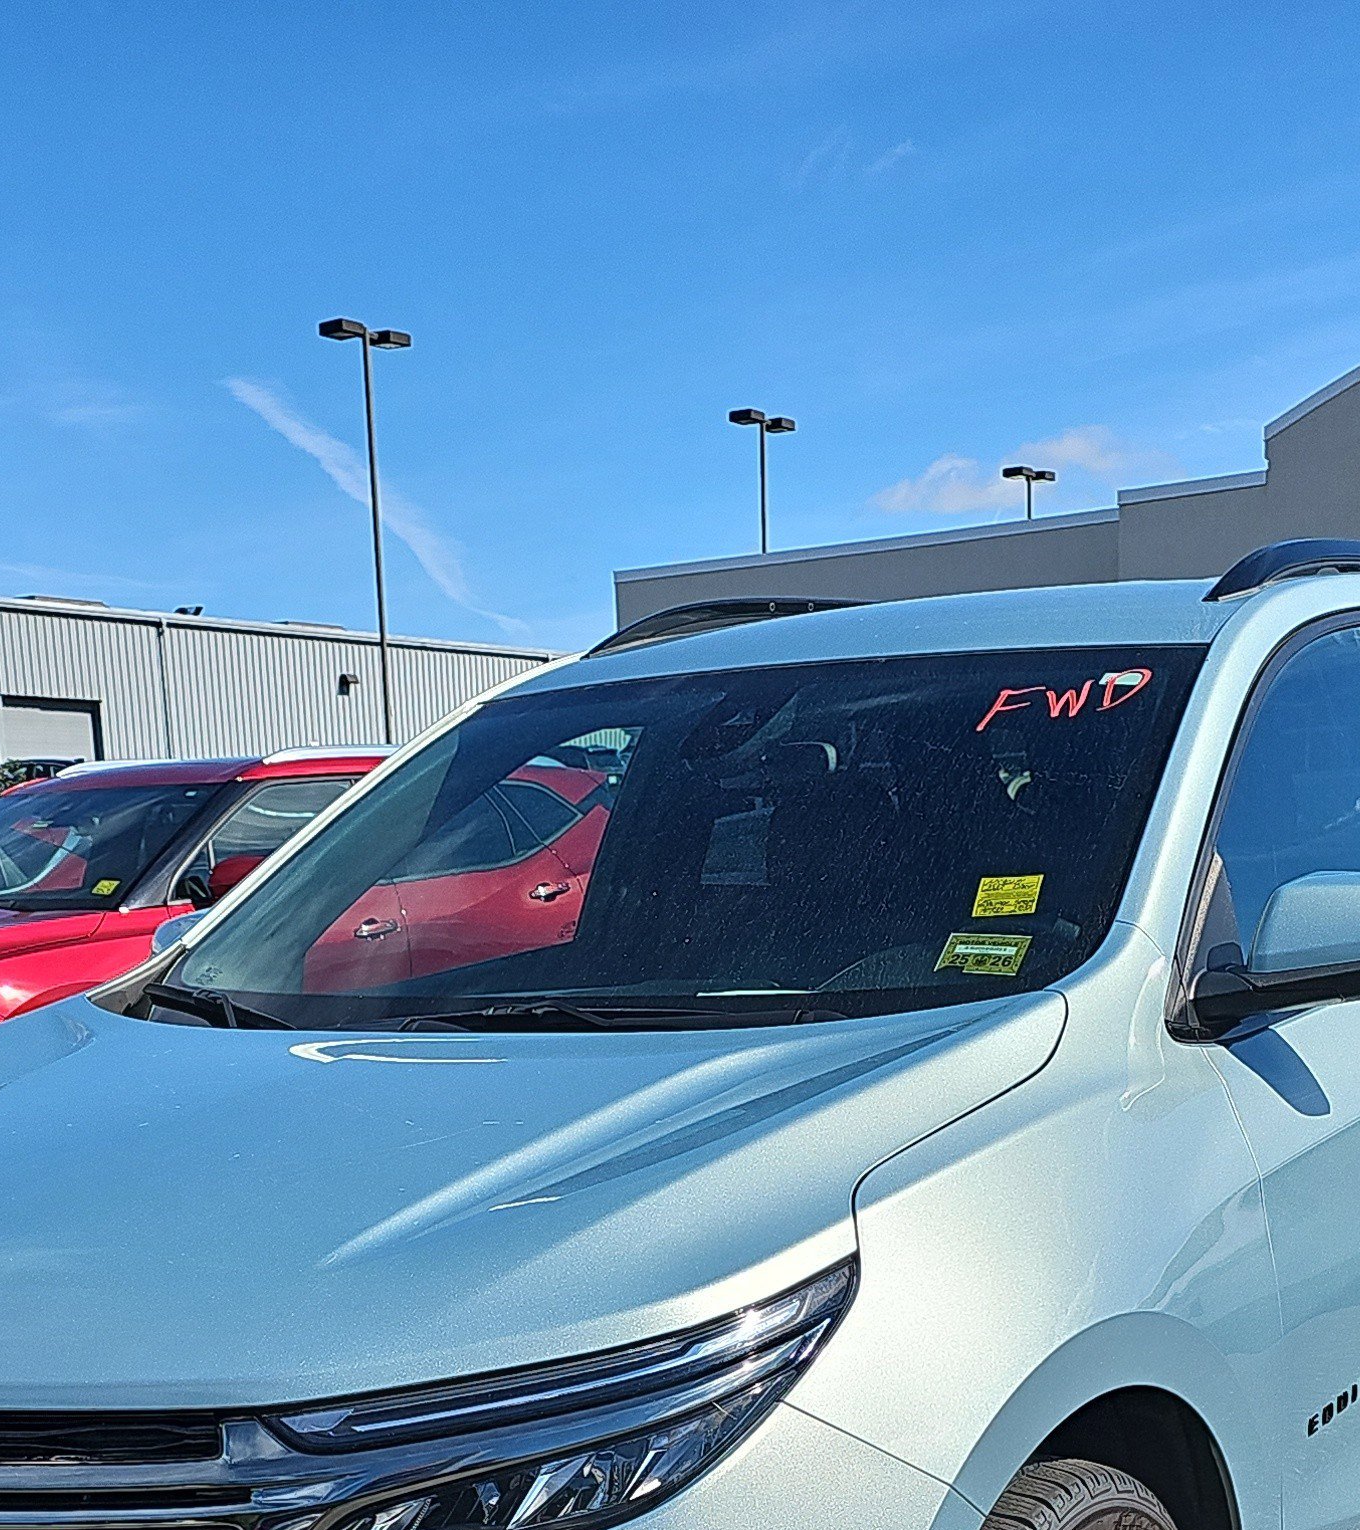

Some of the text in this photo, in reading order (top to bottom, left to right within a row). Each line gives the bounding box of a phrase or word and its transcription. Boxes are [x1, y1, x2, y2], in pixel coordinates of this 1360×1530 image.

[976, 668, 1152, 731] FWD
[948, 954, 1013, 967] 25 26
